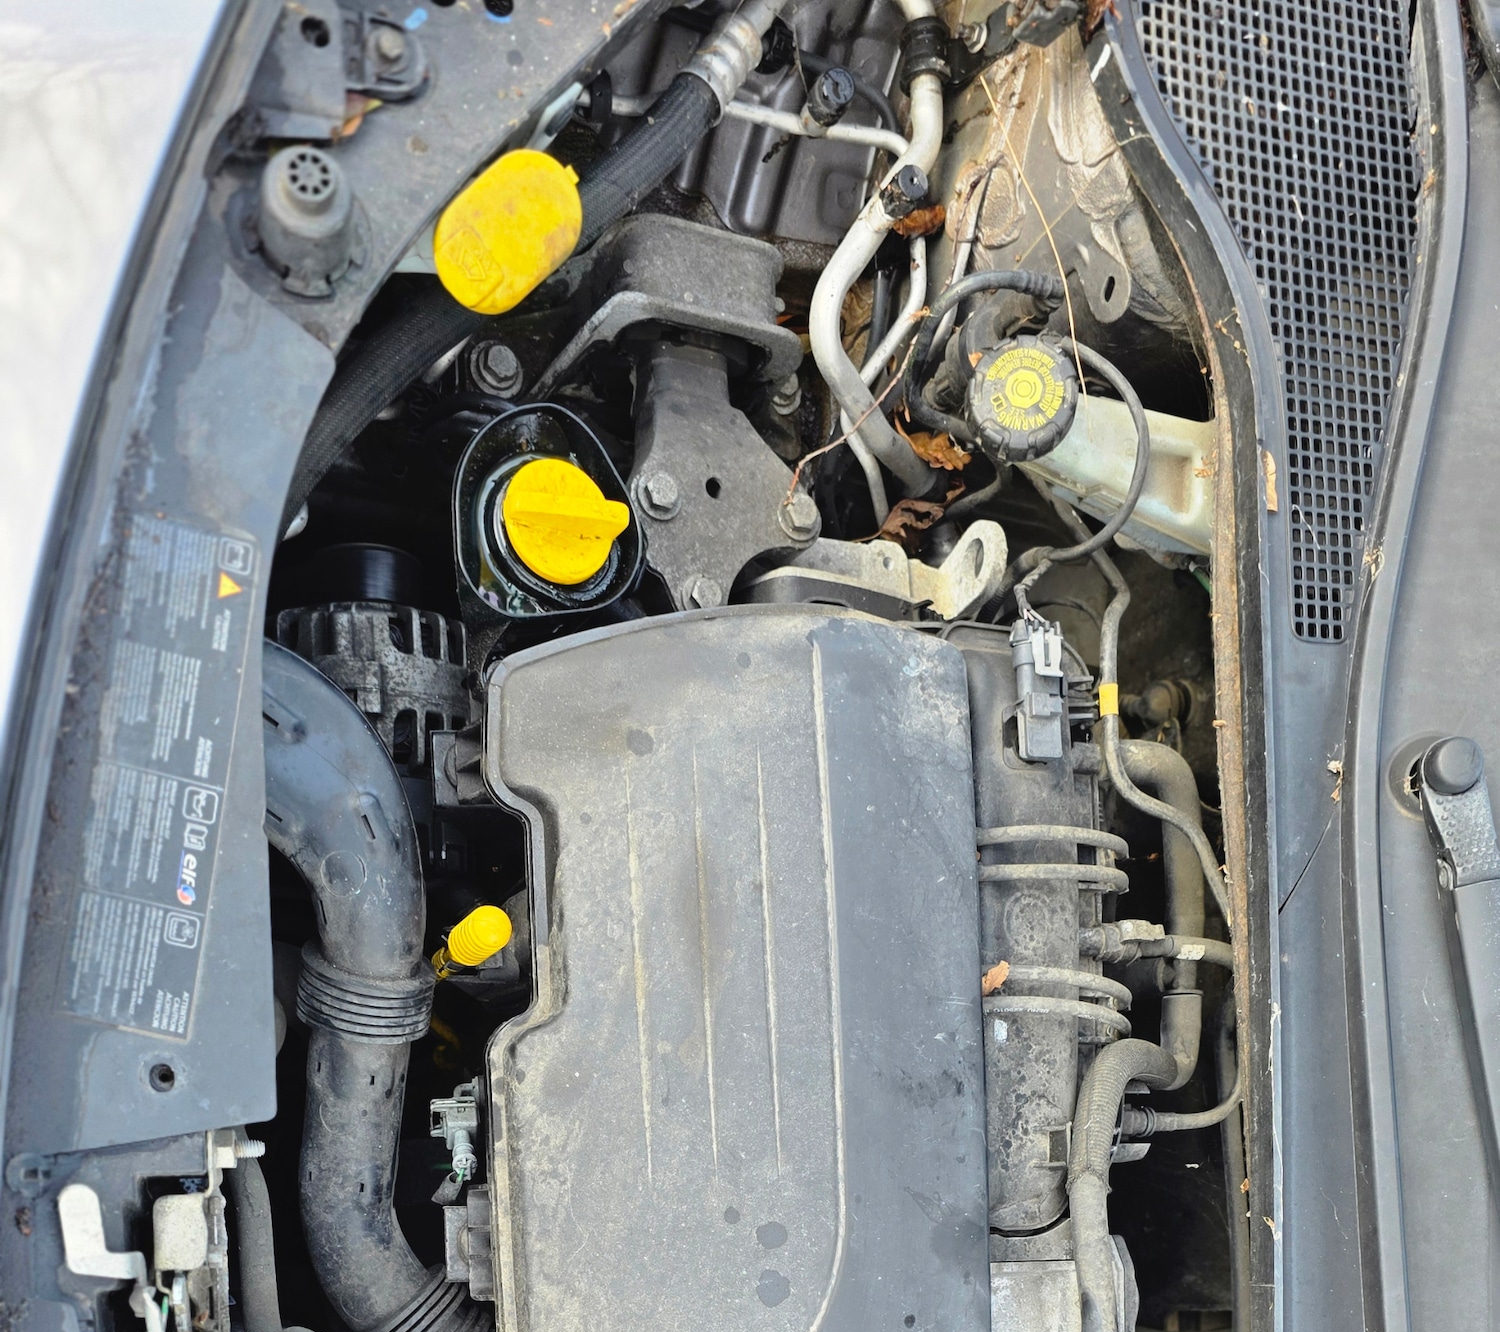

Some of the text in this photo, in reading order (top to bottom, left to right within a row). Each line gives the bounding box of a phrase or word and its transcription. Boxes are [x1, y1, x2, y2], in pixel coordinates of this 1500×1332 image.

[997, 412, 1046, 430] WARNING
[1008, 407, 1025, 418] SEE
[211, 613, 222, 649] CAUTION
[218, 608, 230, 651] ATTENTION
[200, 738, 212, 778] ACHTUNG
[182, 852, 198, 887] elf
[160, 991, 172, 1030] ACHTUNG
[168, 996, 180, 1032] CAUTION
[176, 990, 189, 1034] ATTENTION
